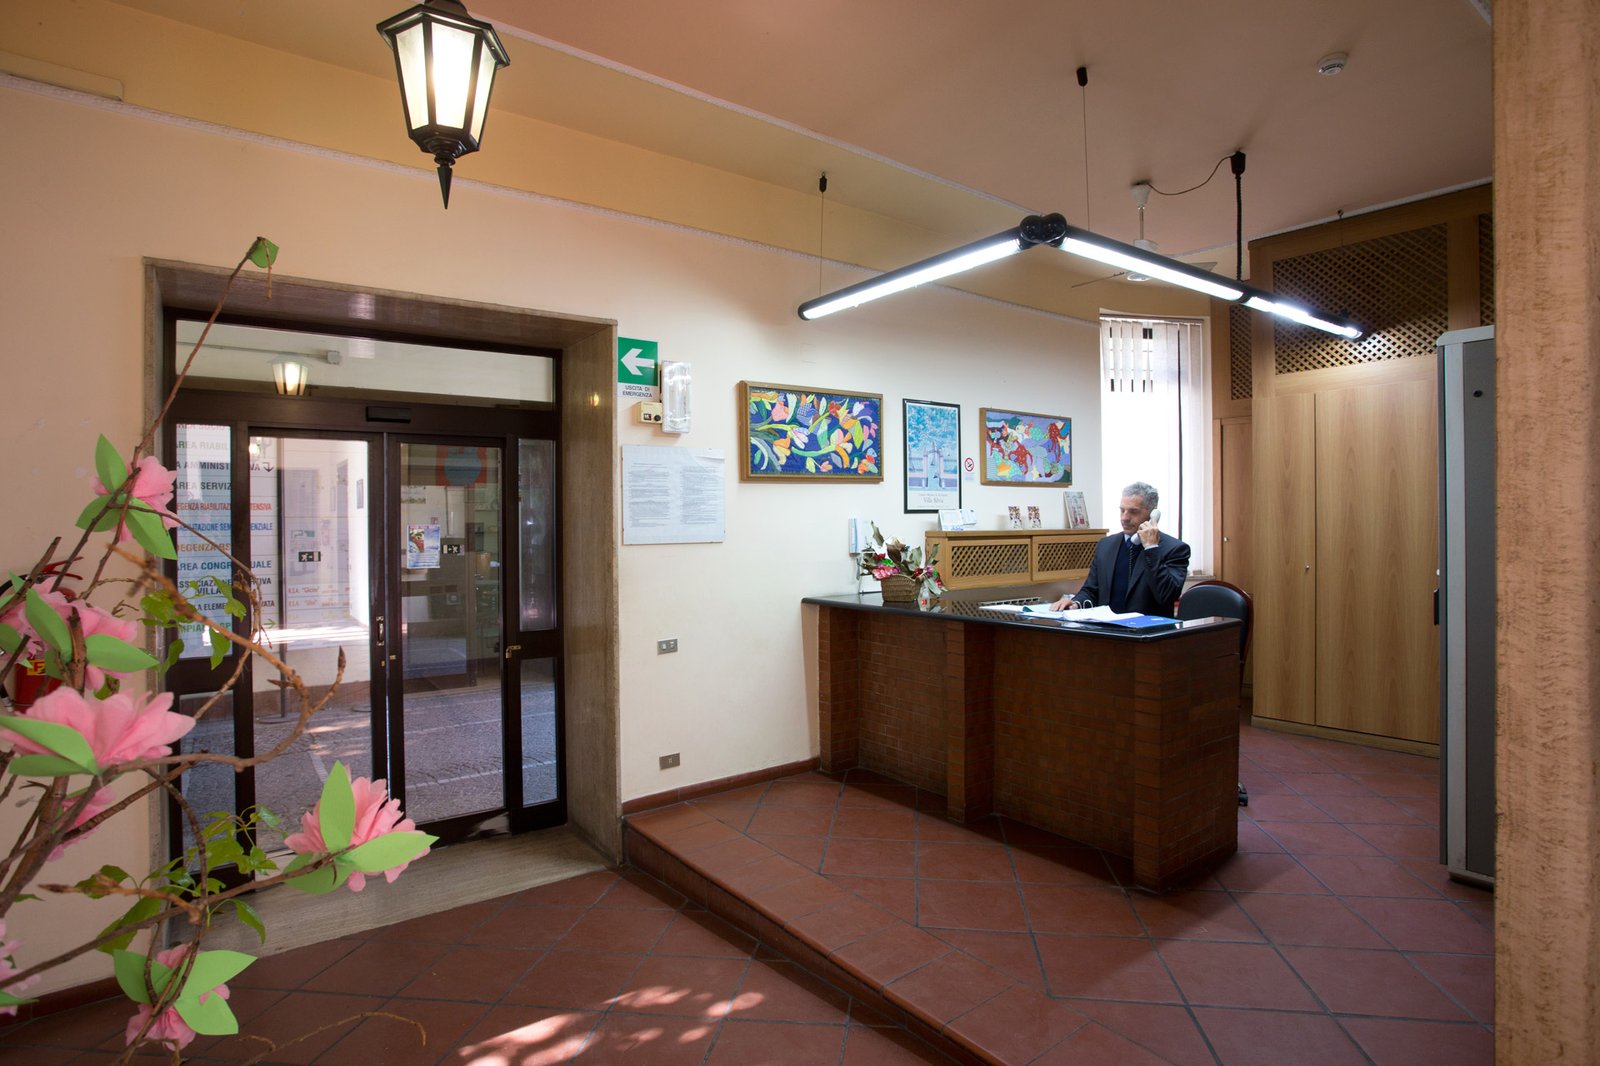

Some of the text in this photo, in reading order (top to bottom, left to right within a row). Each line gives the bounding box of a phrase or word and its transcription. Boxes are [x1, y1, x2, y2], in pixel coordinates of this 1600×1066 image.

[176, 440, 230, 450] REA RIABIL
[176, 481, 231, 491] REA SERVIZ
[177, 502, 200, 511] EGENZA
[177, 562, 199, 571] REA
